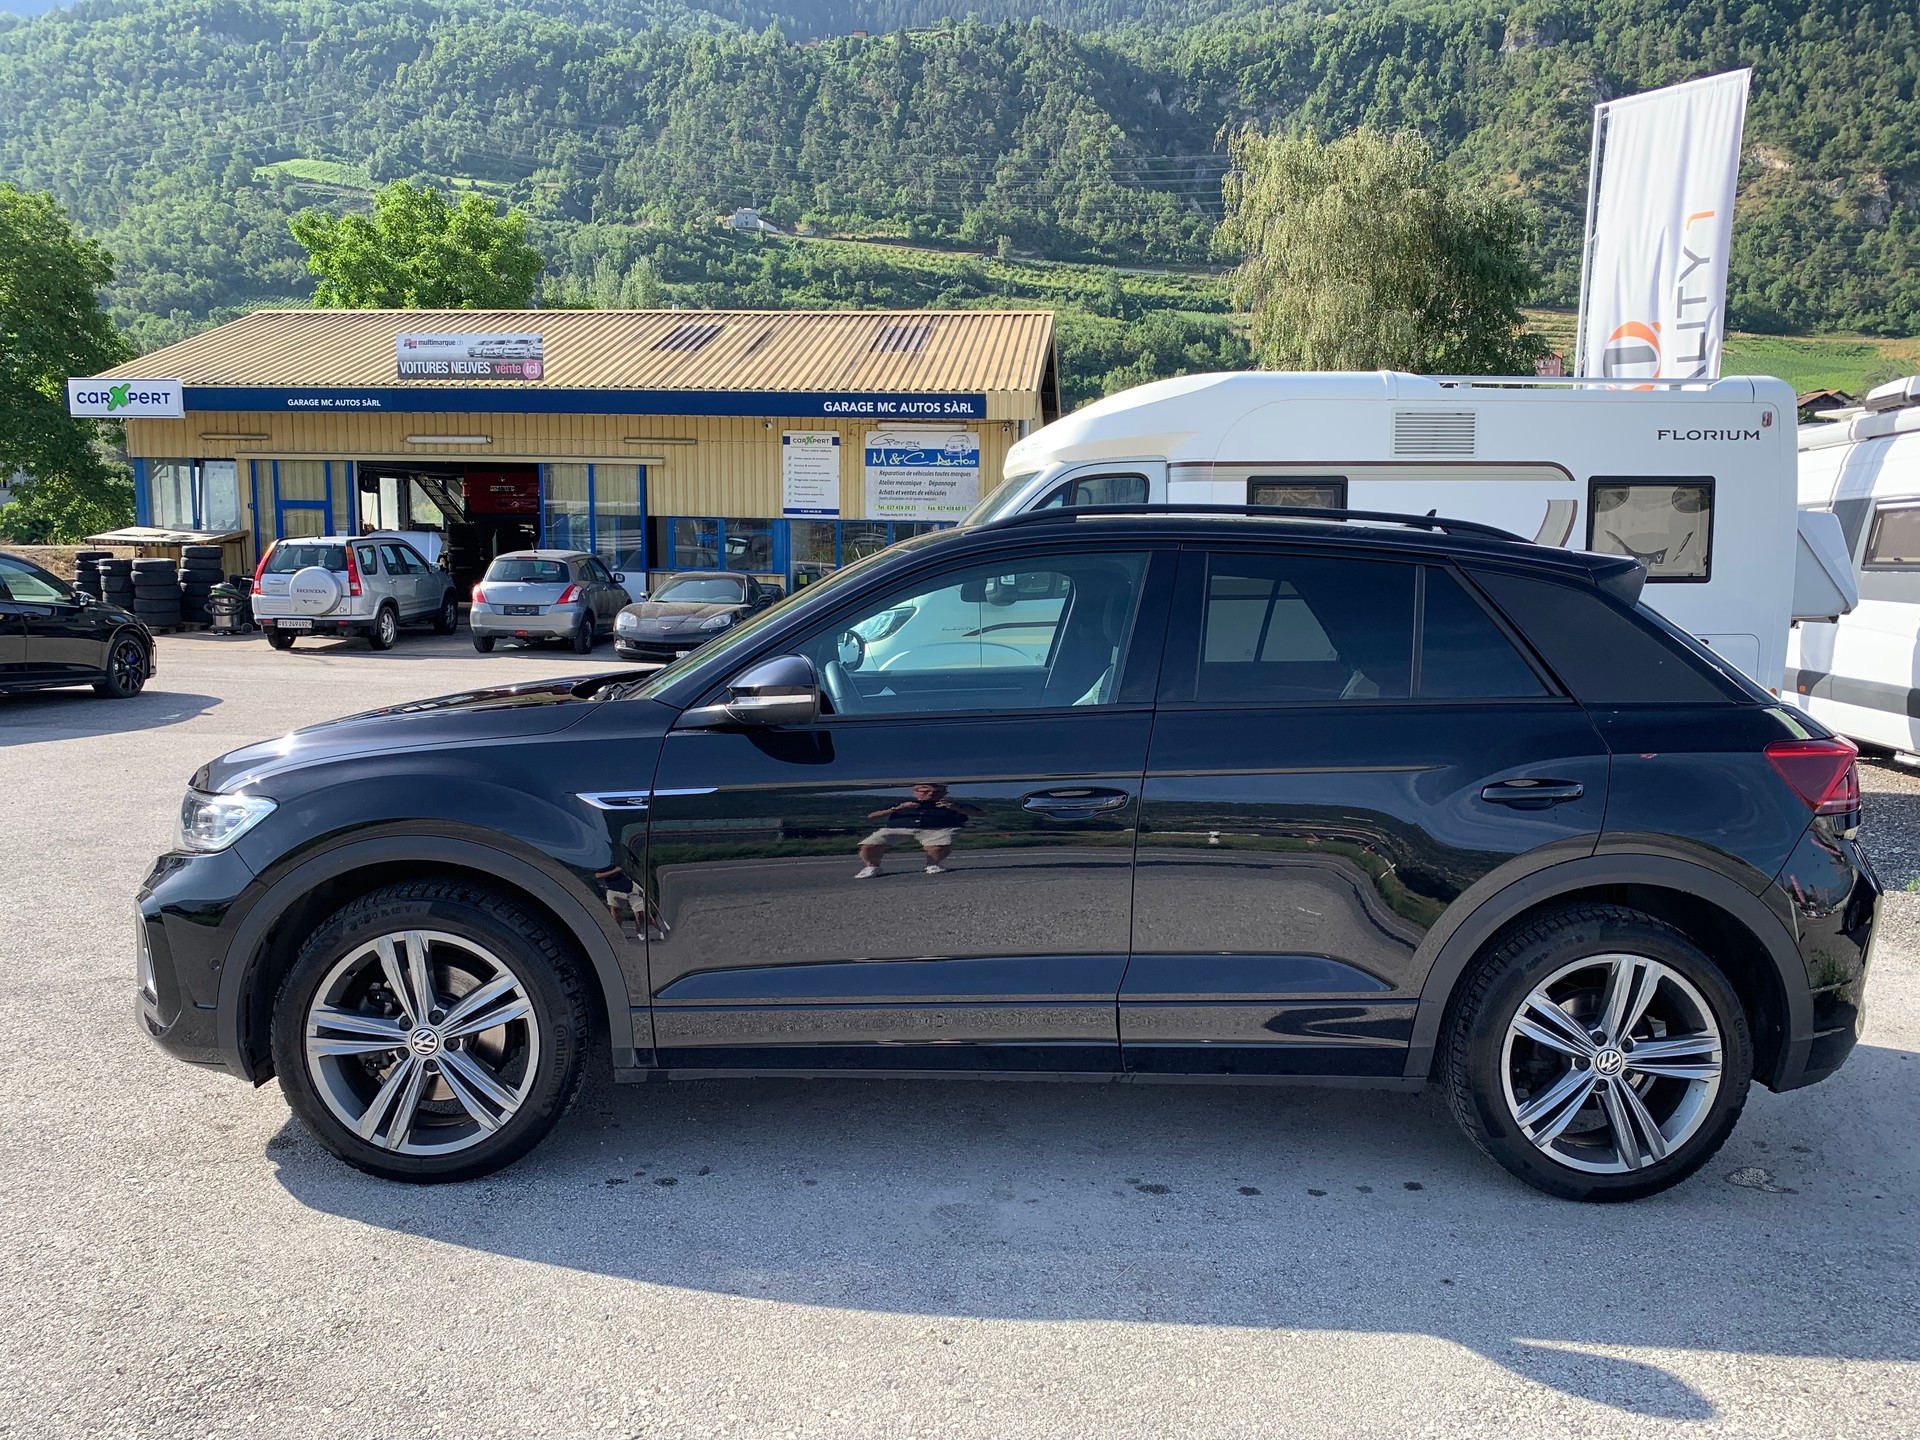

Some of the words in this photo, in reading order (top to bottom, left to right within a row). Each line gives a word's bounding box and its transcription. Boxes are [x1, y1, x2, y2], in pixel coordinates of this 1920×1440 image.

[400, 361, 449, 374] VOITURES
[451, 361, 491, 374] NEUVES
[495, 363, 521, 374] vente
[526, 362, 538, 374] ici
[287, 398, 320, 407] GARAGE
[321, 399, 333, 407] MC
[335, 399, 361, 407] AUTOS
[362, 398, 381, 407] SÀRL
[823, 401, 874, 413] GARAGE
[877, 402, 897, 413] MC
[900, 402, 941, 413] AUTOS
[943, 400, 974, 413] SÀRL
[1657, 429, 1761, 441] FLORIUM
